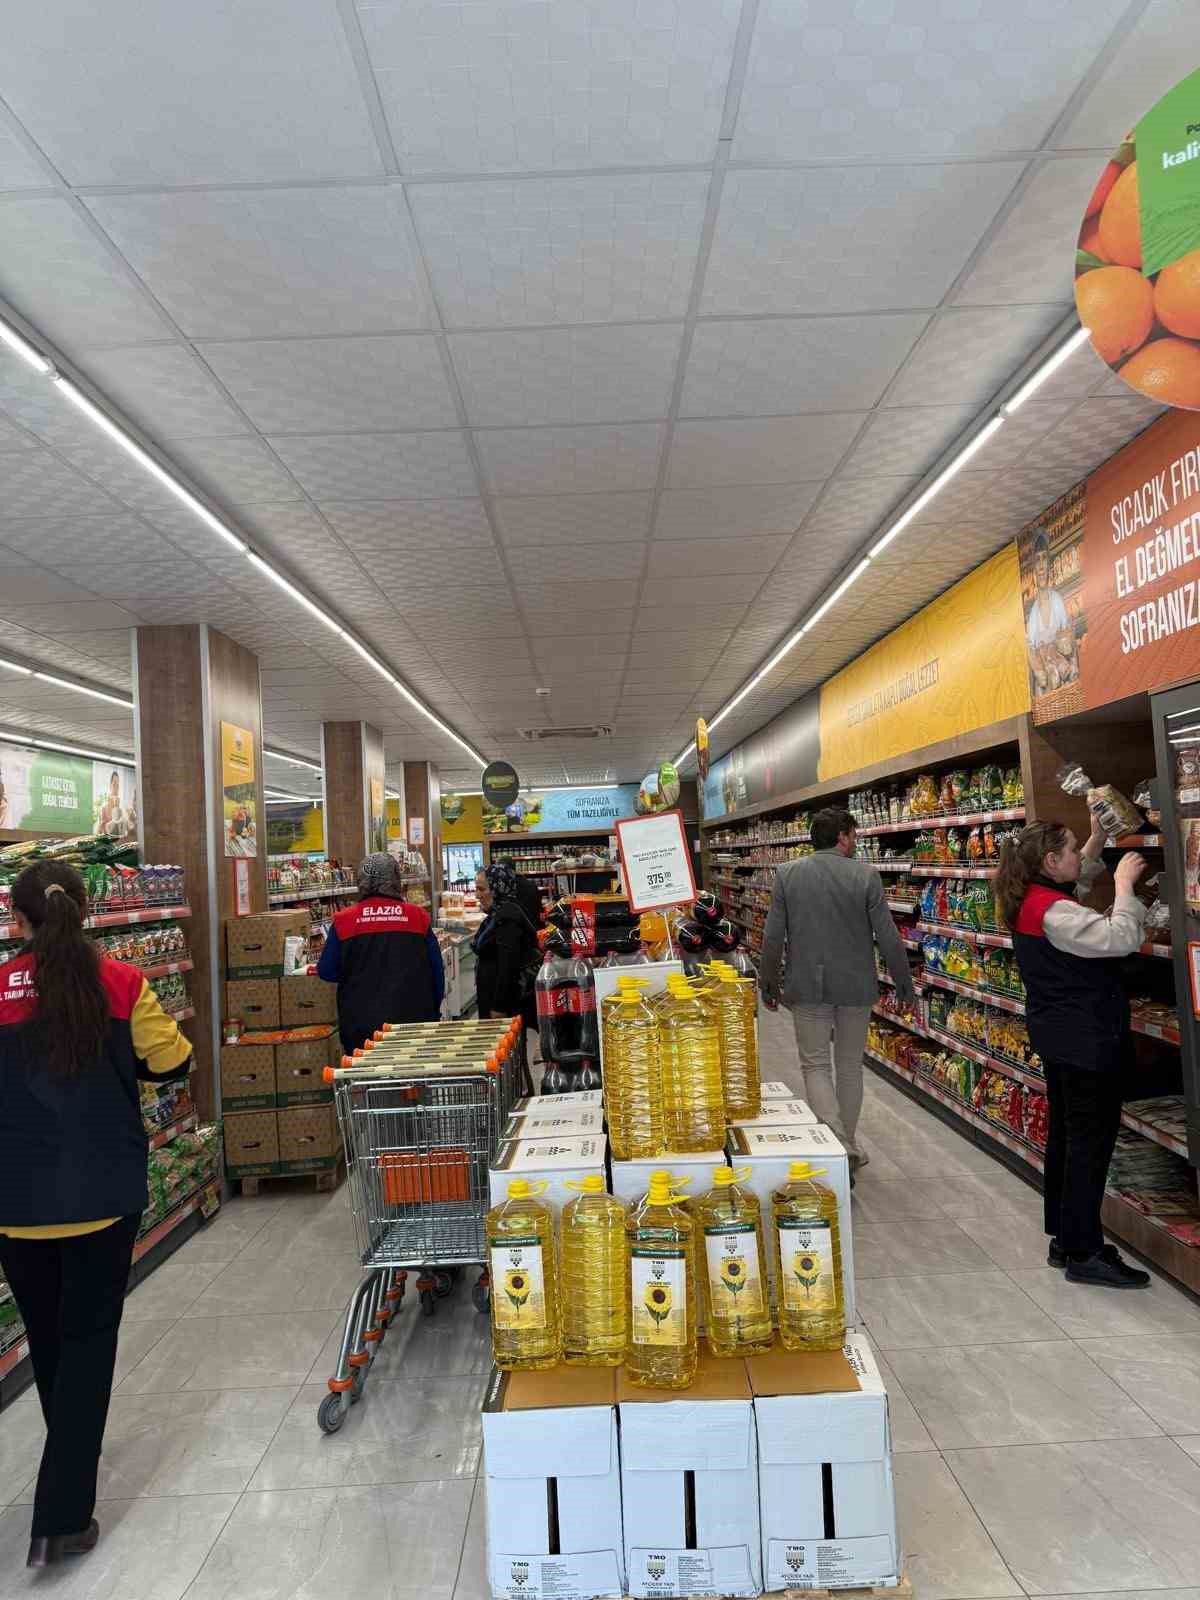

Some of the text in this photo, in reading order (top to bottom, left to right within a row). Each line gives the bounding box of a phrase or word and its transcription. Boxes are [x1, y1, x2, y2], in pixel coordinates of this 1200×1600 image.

[1111, 469, 1169, 545] SICACIK
[1114, 555, 1135, 599] EL
[1119, 578, 1200, 655] SOFRANIZ
[647, 872, 664, 885] 375
[8, 970, 34, 987] EL
